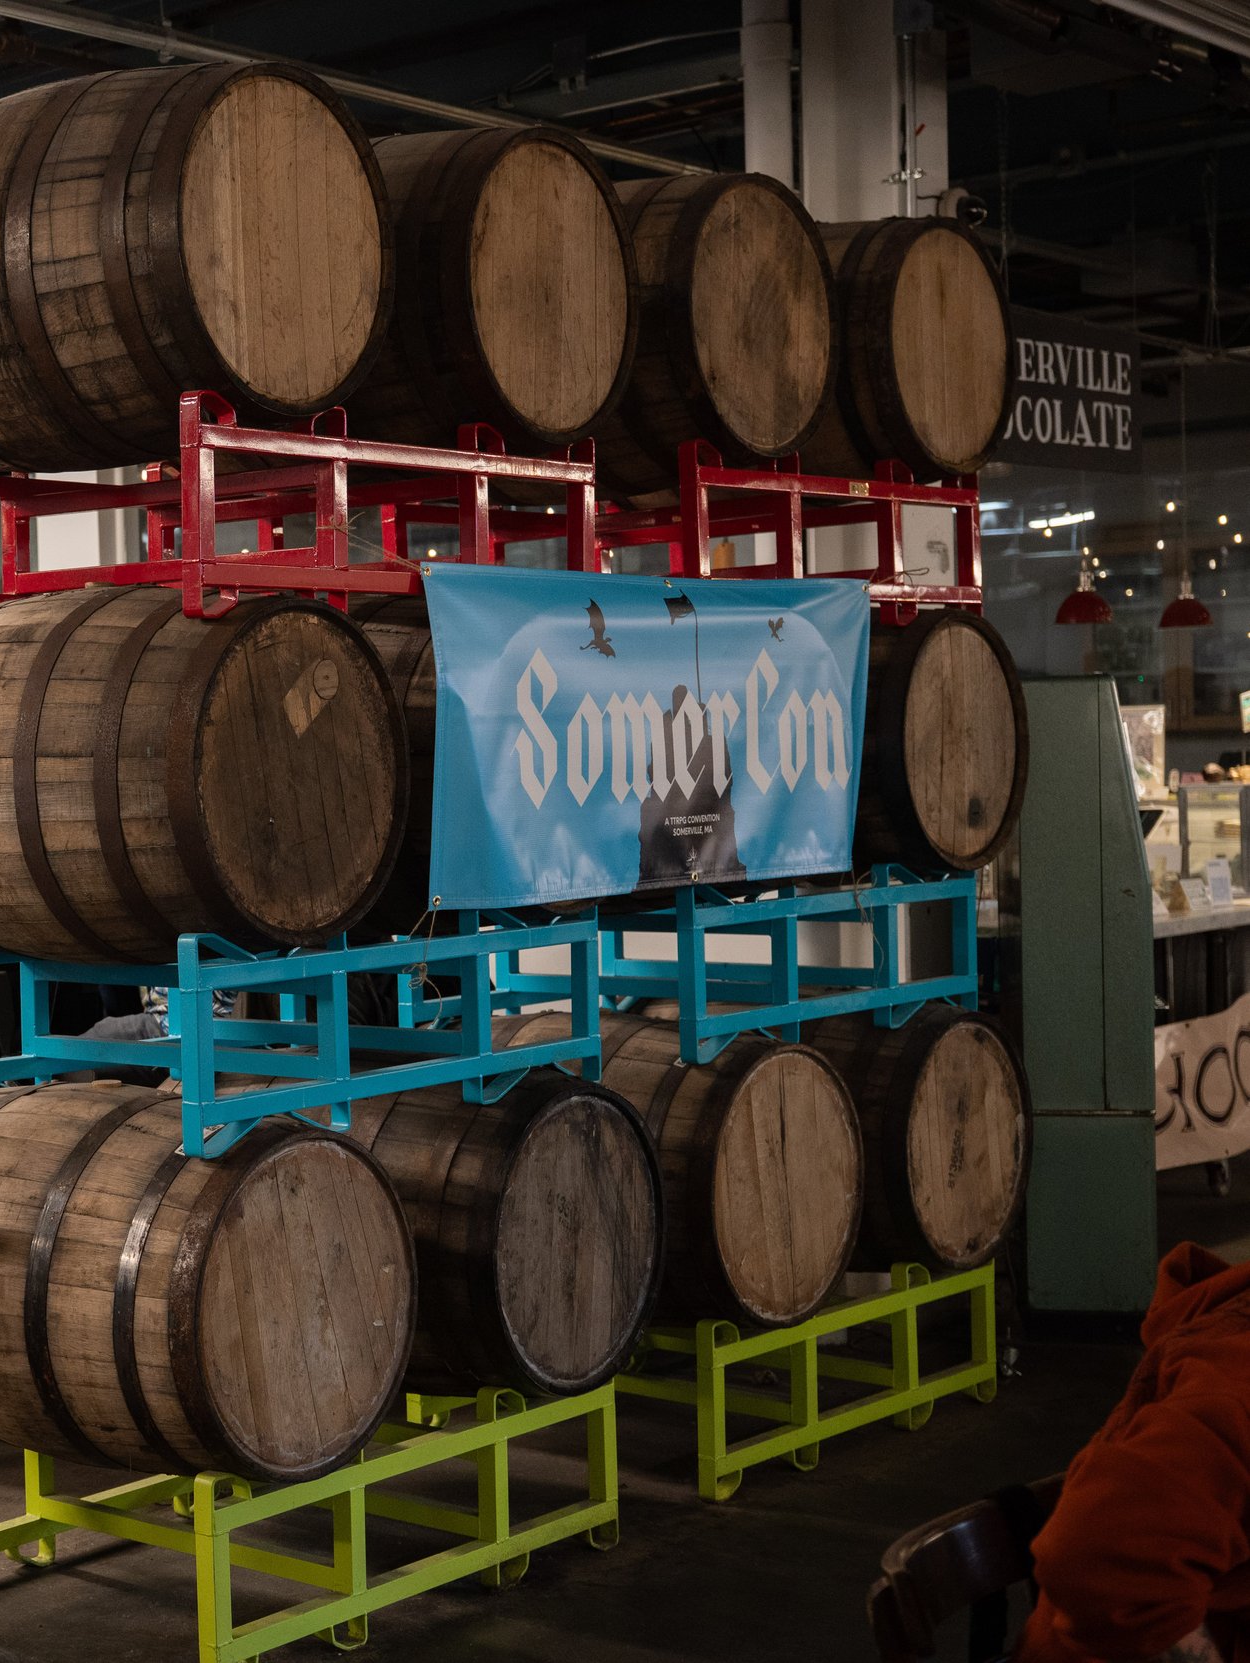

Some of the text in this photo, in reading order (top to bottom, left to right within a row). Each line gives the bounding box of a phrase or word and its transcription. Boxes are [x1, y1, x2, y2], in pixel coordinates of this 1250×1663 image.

[1016, 337, 1132, 396] ERVILLE
[1003, 395, 1133, 451] COLATE
[510, 647, 853, 810] SomerCon
[664, 813, 721, 826] A TTRPG CONVENTION
[673, 825, 713, 836] SOMERVILLE, MA
